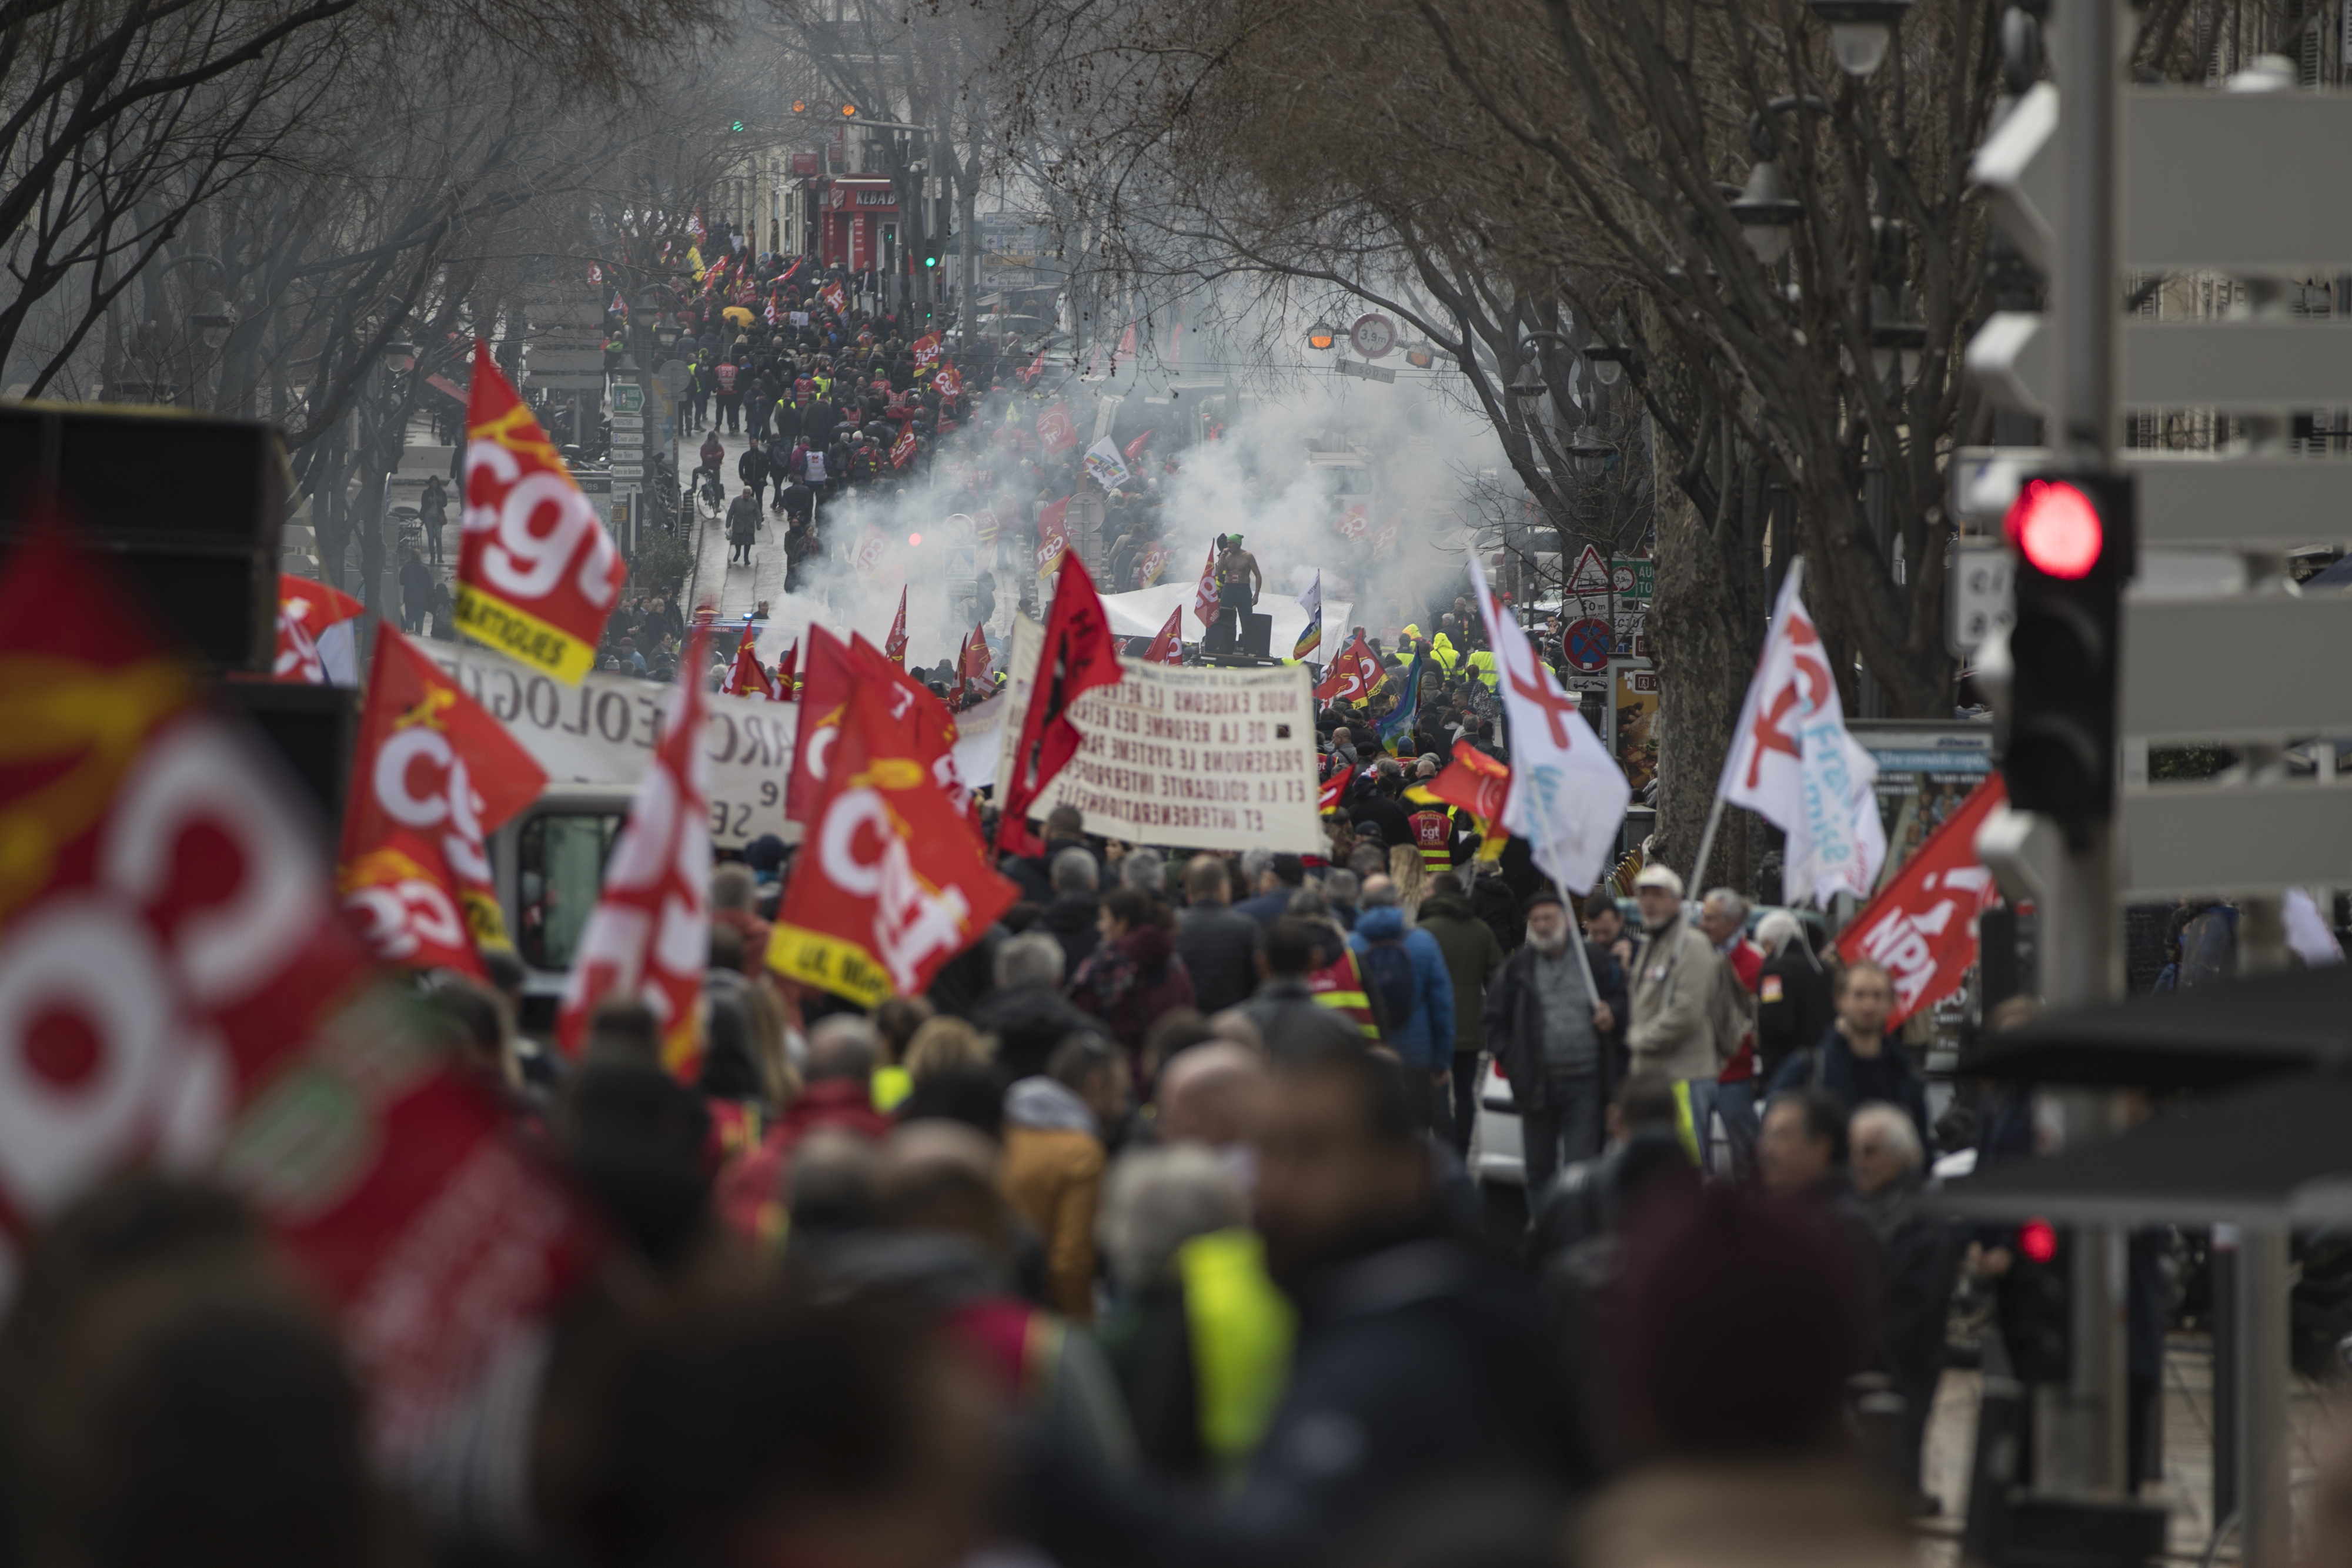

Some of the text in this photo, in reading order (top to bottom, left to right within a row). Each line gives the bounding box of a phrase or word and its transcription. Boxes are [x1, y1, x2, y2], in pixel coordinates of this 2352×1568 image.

[856, 190, 896, 205] KEBAB
[1360, 329, 1387, 343] 3,9m
[1359, 366, 1389, 380] 500 m
[1615, 576, 1631, 584] 3,9m
[1422, 826, 1439, 840] cgt
[1858, 904, 1939, 1016] NPA
